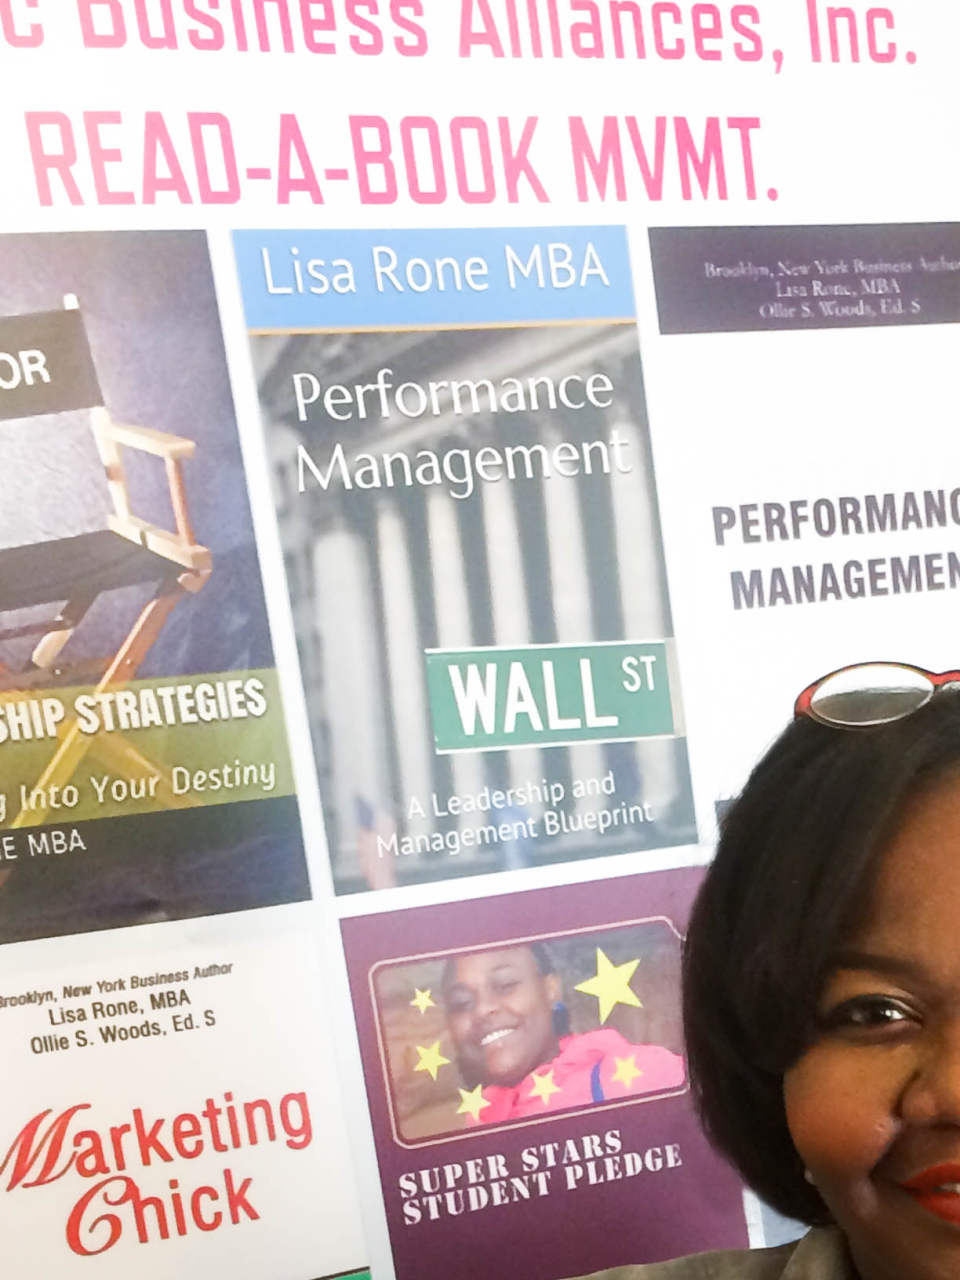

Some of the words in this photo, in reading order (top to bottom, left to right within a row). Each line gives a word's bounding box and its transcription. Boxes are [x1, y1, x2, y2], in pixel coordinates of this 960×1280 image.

[78, 0, 428, 57] Business
[459, 0, 784, 73] Alliances,
[806, 0, 917, 64] Inc.
[24, 111, 551, 206] READ-A-BOOK
[569, 116, 778, 202] MVMT.
[262, 247, 356, 295] Lisa
[372, 246, 488, 292] Rone
[505, 243, 610, 289] MBA
[776, 280, 808, 297] Lisa
[861, 278, 901, 294] MBA
[293, 368, 614, 422] Performance
[297, 430, 633, 499] Management
[75, 678, 267, 735] STRATEGIES
[448, 658, 619, 736] WALL
[622, 656, 656, 692] ST
[20, 785, 78, 811] Into
[90, 774, 160, 802] Your
[172, 760, 276, 795] Destiny
[408, 796, 426, 819] A
[433, 779, 565, 818] Leadership
[573, 771, 616, 796] and
[28, 829, 87, 857] MBA
[377, 817, 538, 859] Management
[544, 802, 655, 836] Blueprint
[49, 1006, 87, 1026] Lisa
[92, 999, 144, 1020] Rone,
[149, 989, 191, 1011] MBA
[63, 985, 92, 999] New
[97, 977, 126, 994] York
[130, 969, 189, 990] Business
[194, 963, 233, 980] Author
[31, 1033, 70, 1054] Ollie
[75, 1029, 94, 1048] S.
[99, 1020, 167, 1044] Woods,
[172, 1013, 200, 1033] Ed.
[204, 1009, 216, 1027] S
[0, 1091, 312, 1192] Marketing
[398, 1154, 510, 1199] SUPER
[521, 1130, 624, 1172] STARS
[66, 1168, 260, 1256] Chick
[403, 1171, 552, 1226] STUDENT
[566, 1143, 683, 1190] PLEDGE
